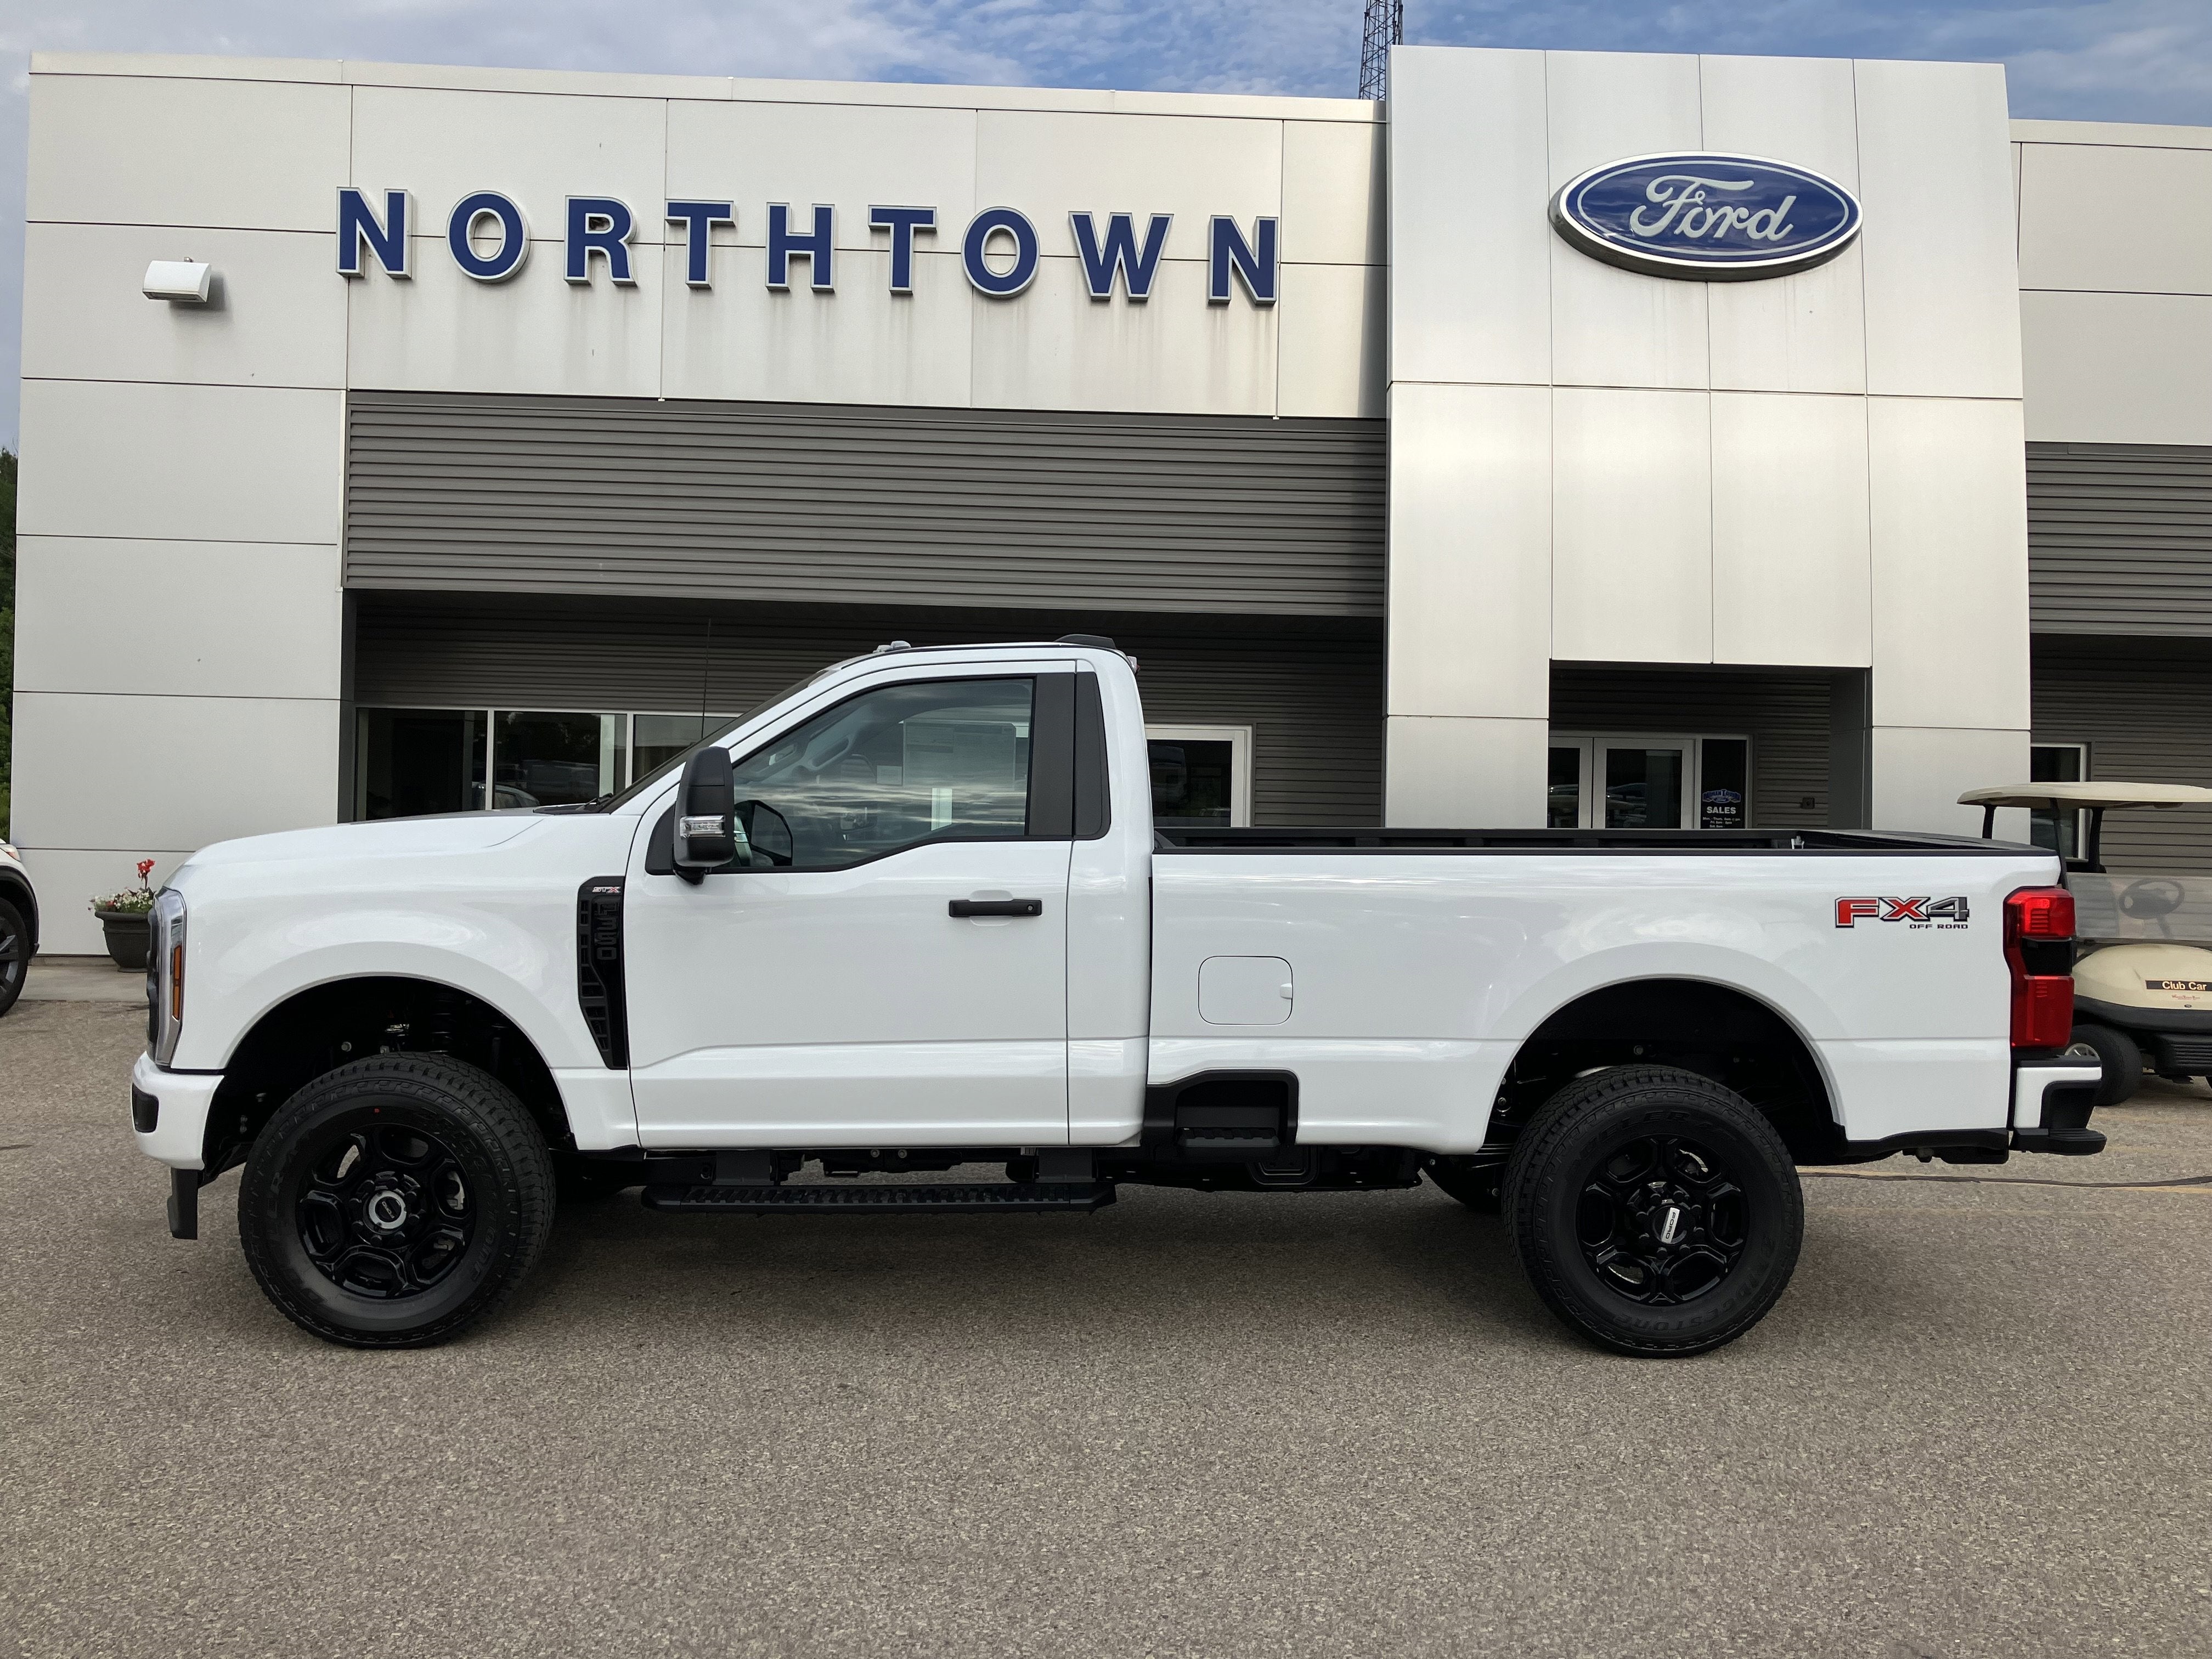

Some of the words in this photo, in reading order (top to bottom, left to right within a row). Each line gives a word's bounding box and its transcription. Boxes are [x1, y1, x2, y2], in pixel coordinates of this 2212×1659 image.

[1629, 174, 1797, 242] Ford
[336, 187, 1279, 306] NORTHTOWN
[592, 886, 621, 894] STX
[1835, 896, 1970, 928] FX4
[2162, 981, 2186, 990] Club
[2188, 981, 2207, 991] Car
[1666, 1212, 1676, 1239] FORD
